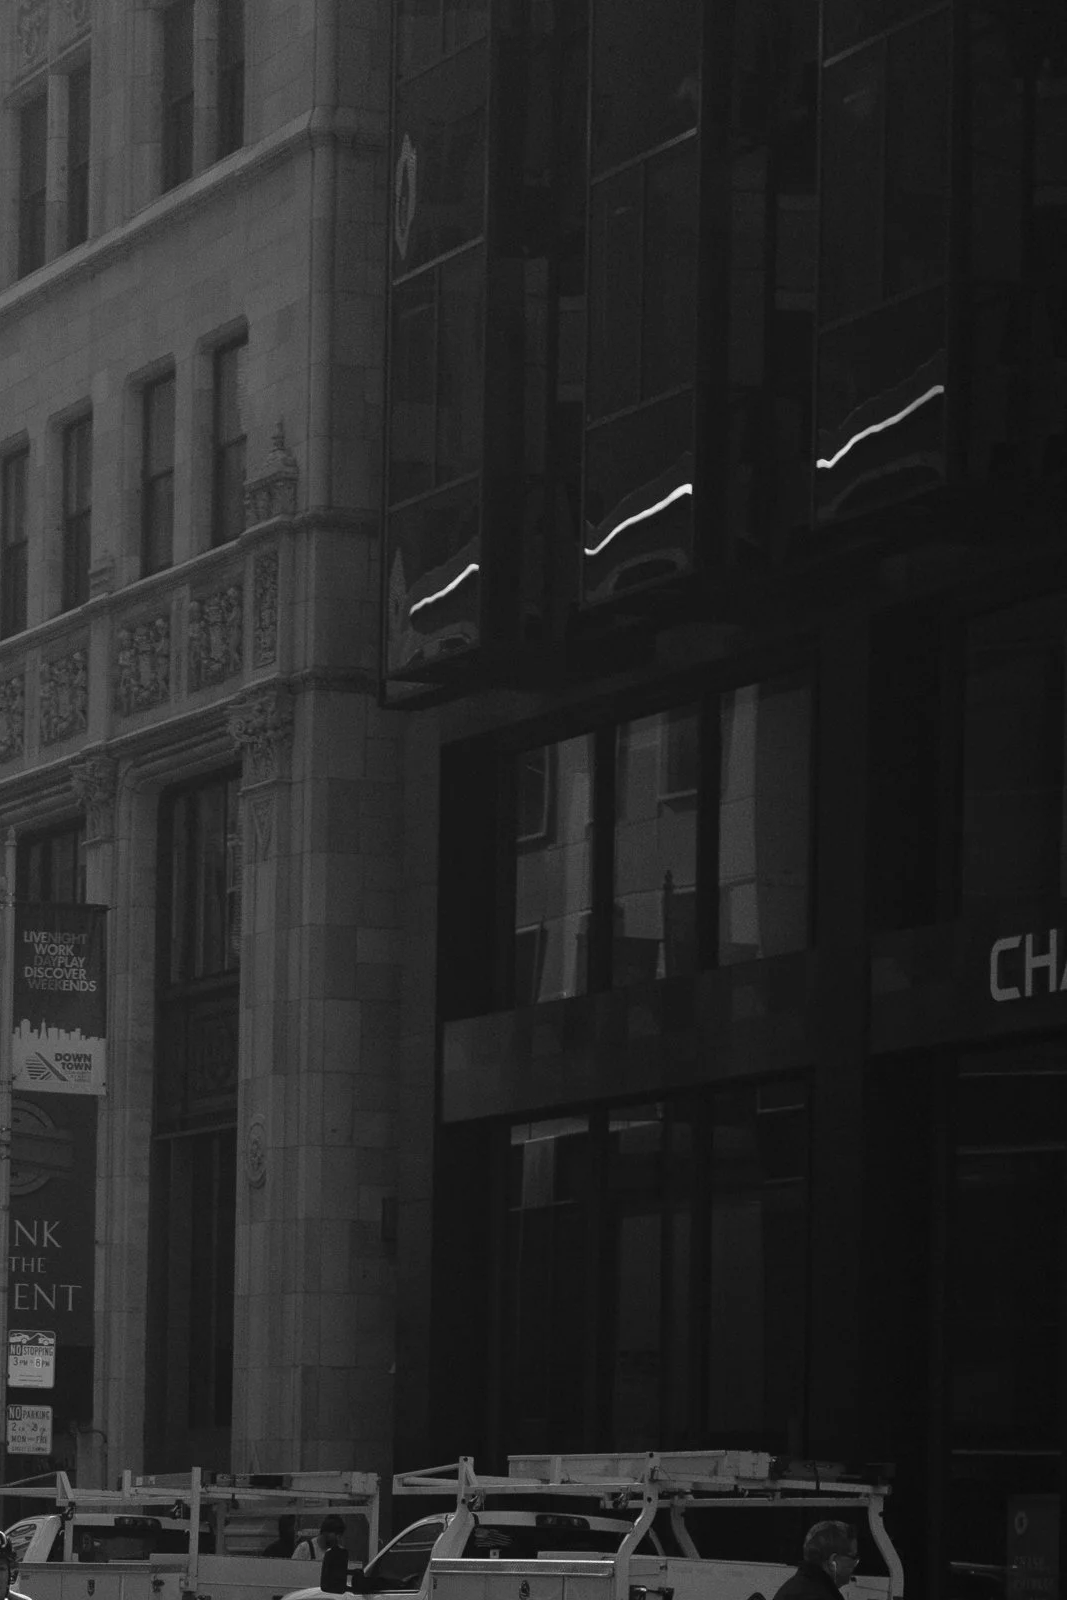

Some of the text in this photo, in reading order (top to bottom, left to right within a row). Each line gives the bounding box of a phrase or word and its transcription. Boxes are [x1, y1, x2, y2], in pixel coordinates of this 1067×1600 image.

[34, 943, 75, 956] WORK
[989, 928, 1067, 1002] CH
[24, 966, 87, 980] DISCOVER
[54, 1053, 92, 1062] DOWN
[61, 1062, 92, 1071] TOWN
[8, 1256, 47, 1273] THE
[10, 1344, 22, 1356] NO
[9, 1407, 22, 1419] NO
